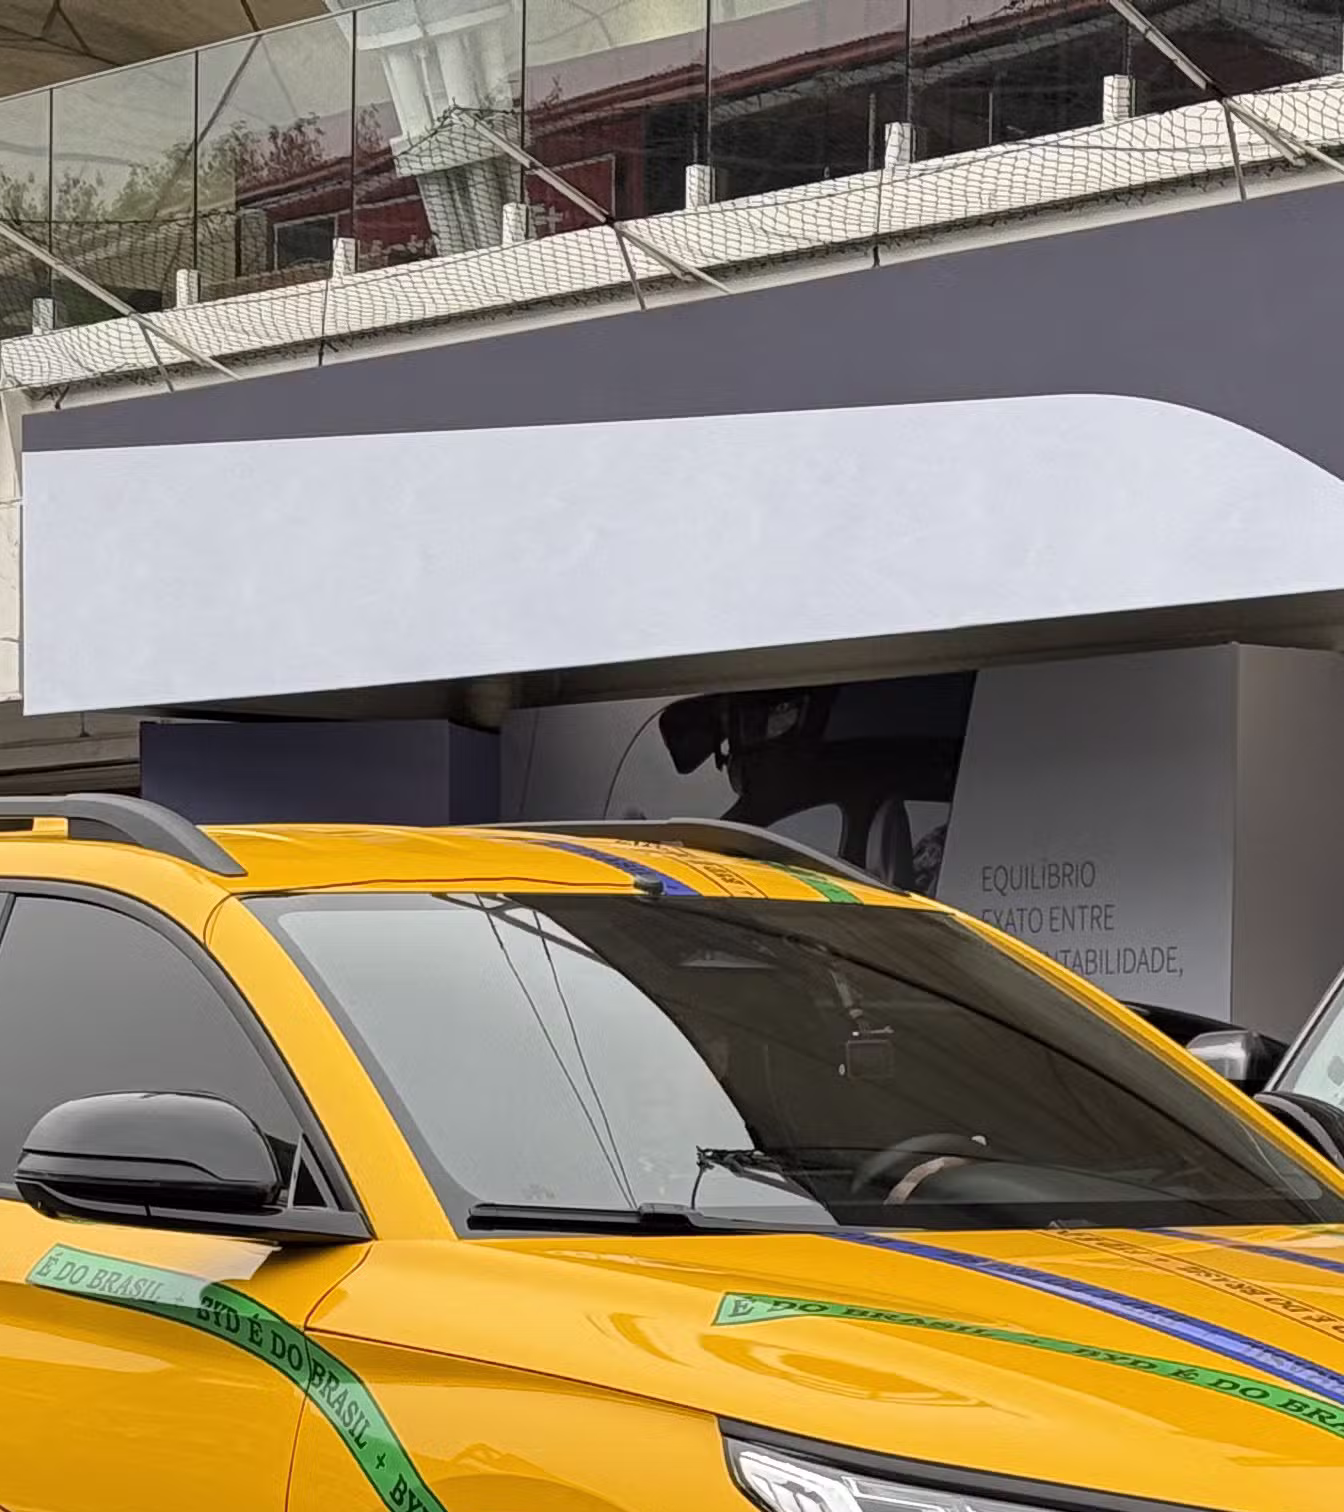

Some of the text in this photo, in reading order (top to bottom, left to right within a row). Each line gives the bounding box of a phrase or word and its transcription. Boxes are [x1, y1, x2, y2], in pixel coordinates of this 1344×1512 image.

[982, 859, 1096, 896] EQUILÍBRIO
[1049, 904, 1115, 933] ENTRE
[195, 1294, 244, 1333] BYD
[247, 1312, 265, 1347] É
[270, 1330, 304, 1371] DO
[308, 1358, 369, 1449] BRASIL
[1207, 1377, 1270, 1400] DO
